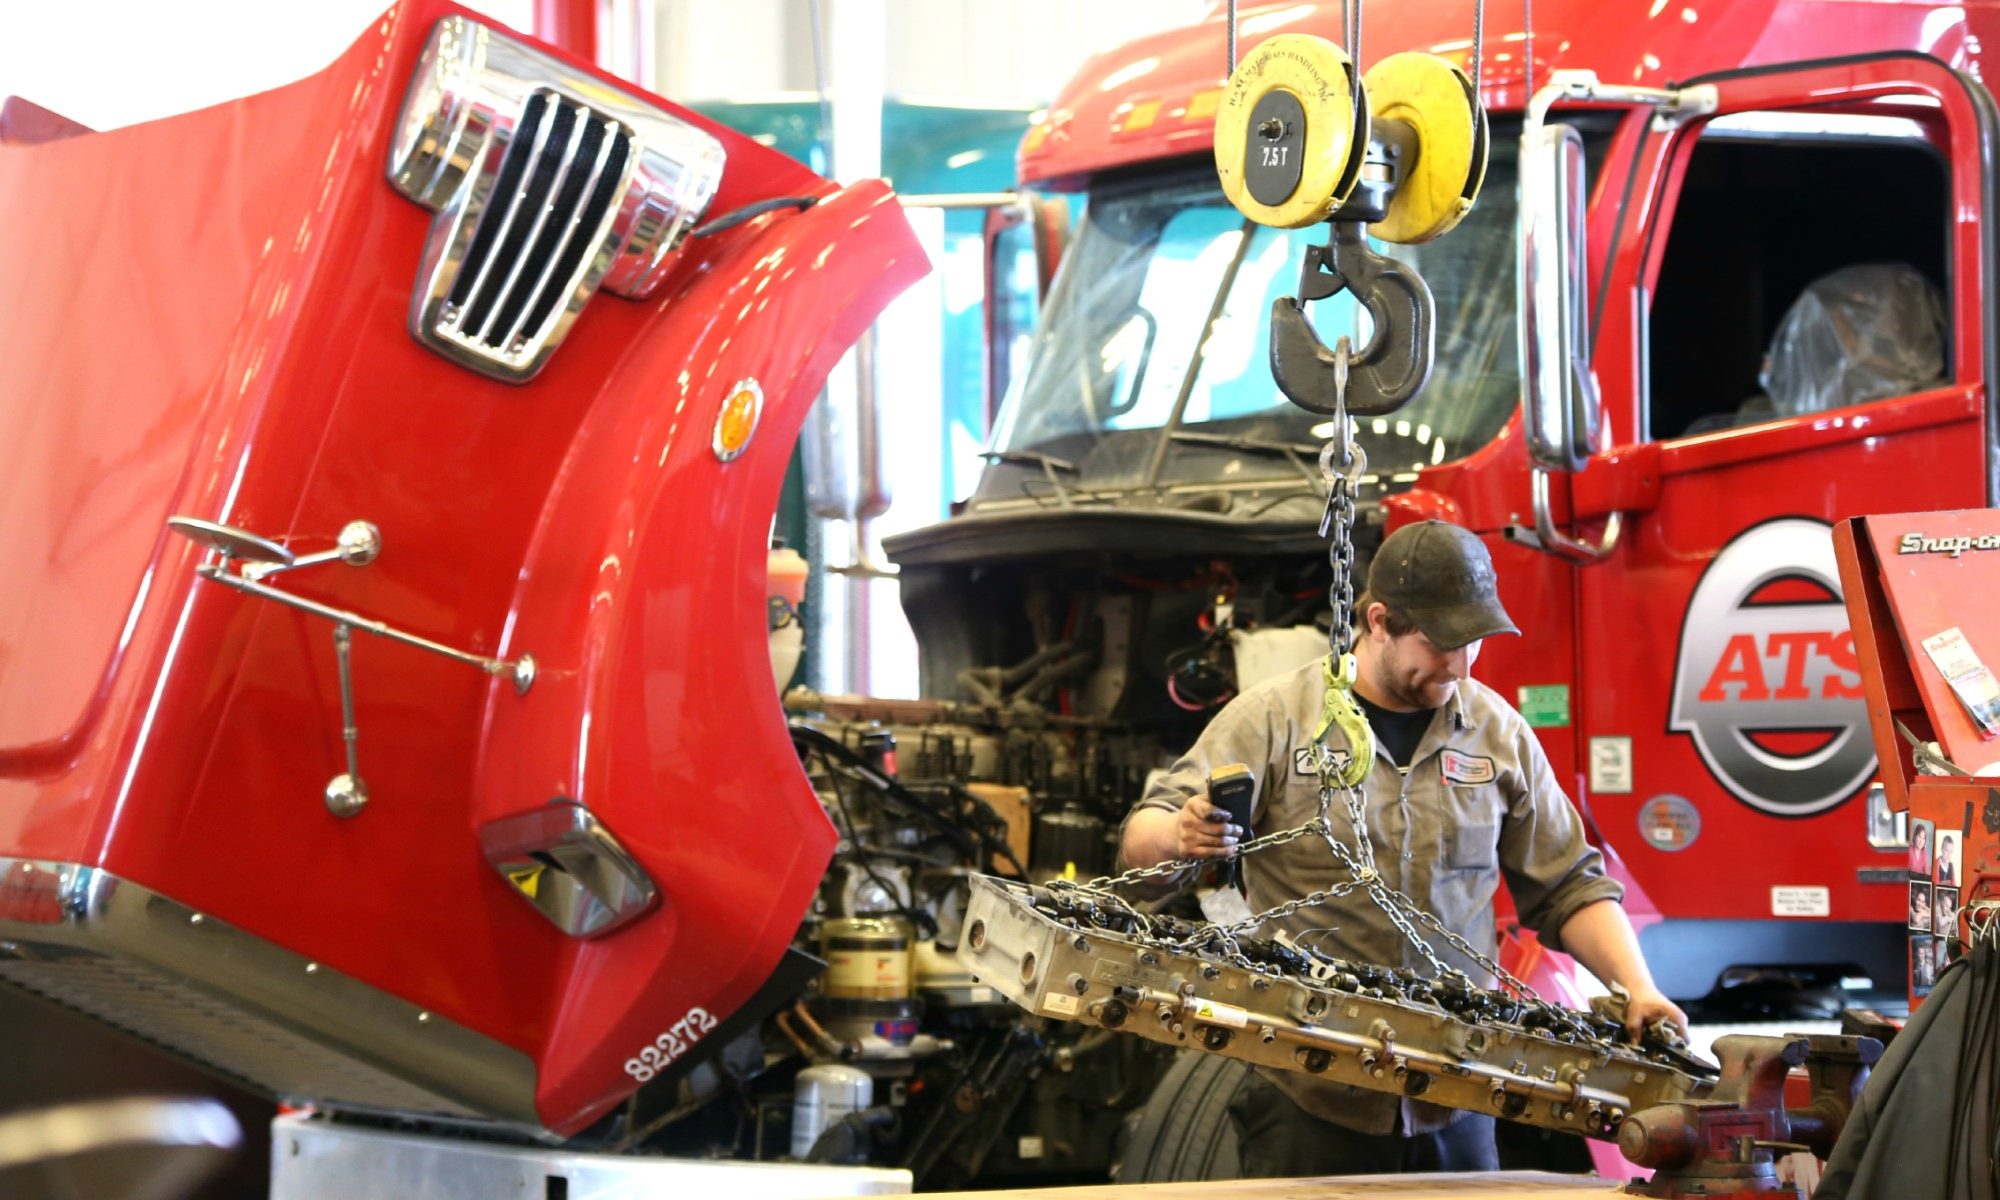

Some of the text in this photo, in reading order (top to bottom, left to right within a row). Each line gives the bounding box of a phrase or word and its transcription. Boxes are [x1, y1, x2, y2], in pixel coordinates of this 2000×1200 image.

[1263, 147, 1288, 166] 7.5 T
[1698, 631, 1865, 702] ATS
[624, 1006, 719, 1083] 82272
